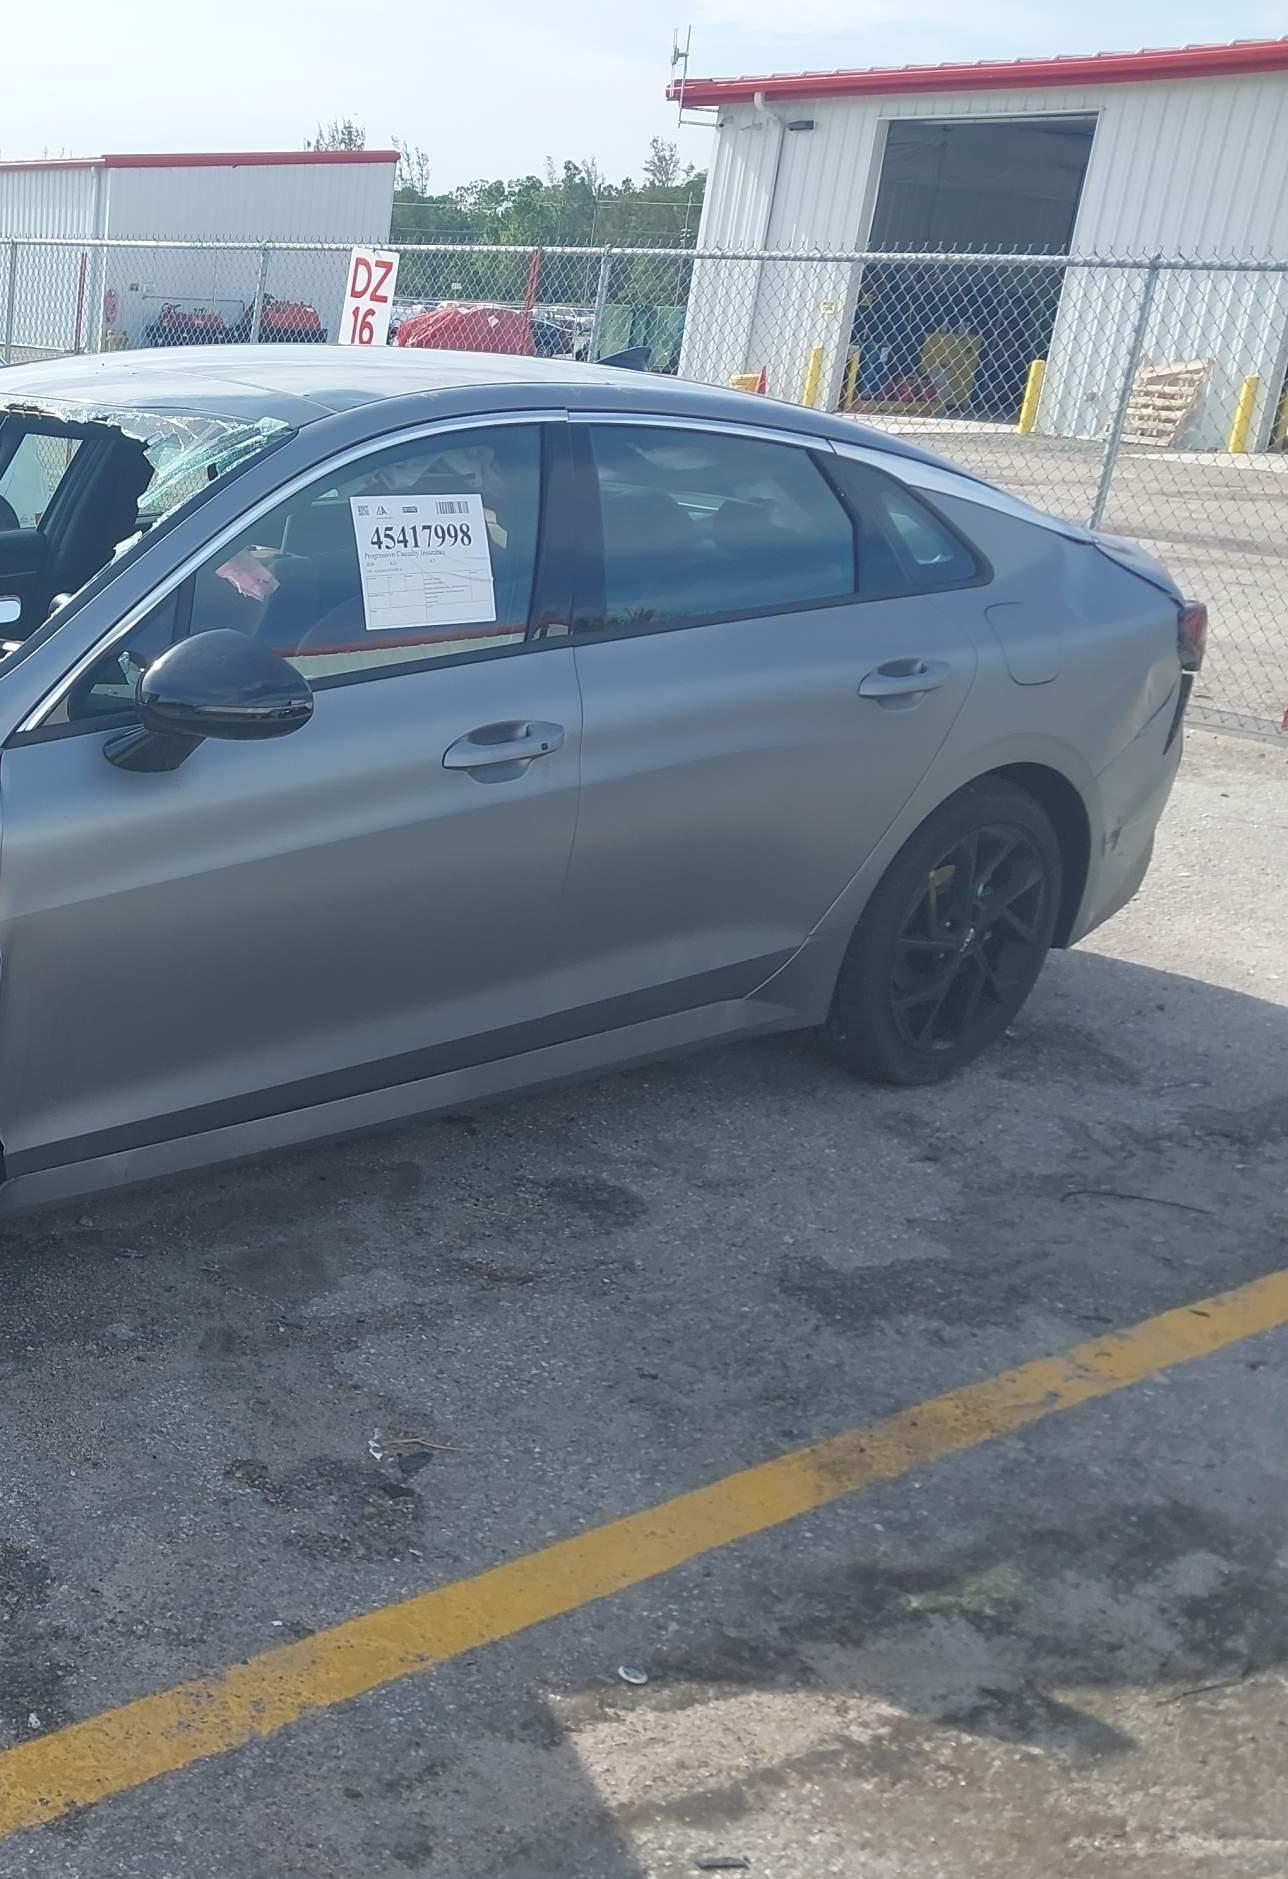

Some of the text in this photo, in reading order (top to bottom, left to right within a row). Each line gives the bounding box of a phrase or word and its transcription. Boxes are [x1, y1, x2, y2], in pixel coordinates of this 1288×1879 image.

[350, 257, 394, 304] DZ
[351, 306, 376, 345] 16
[370, 522, 472, 550] 45417998
